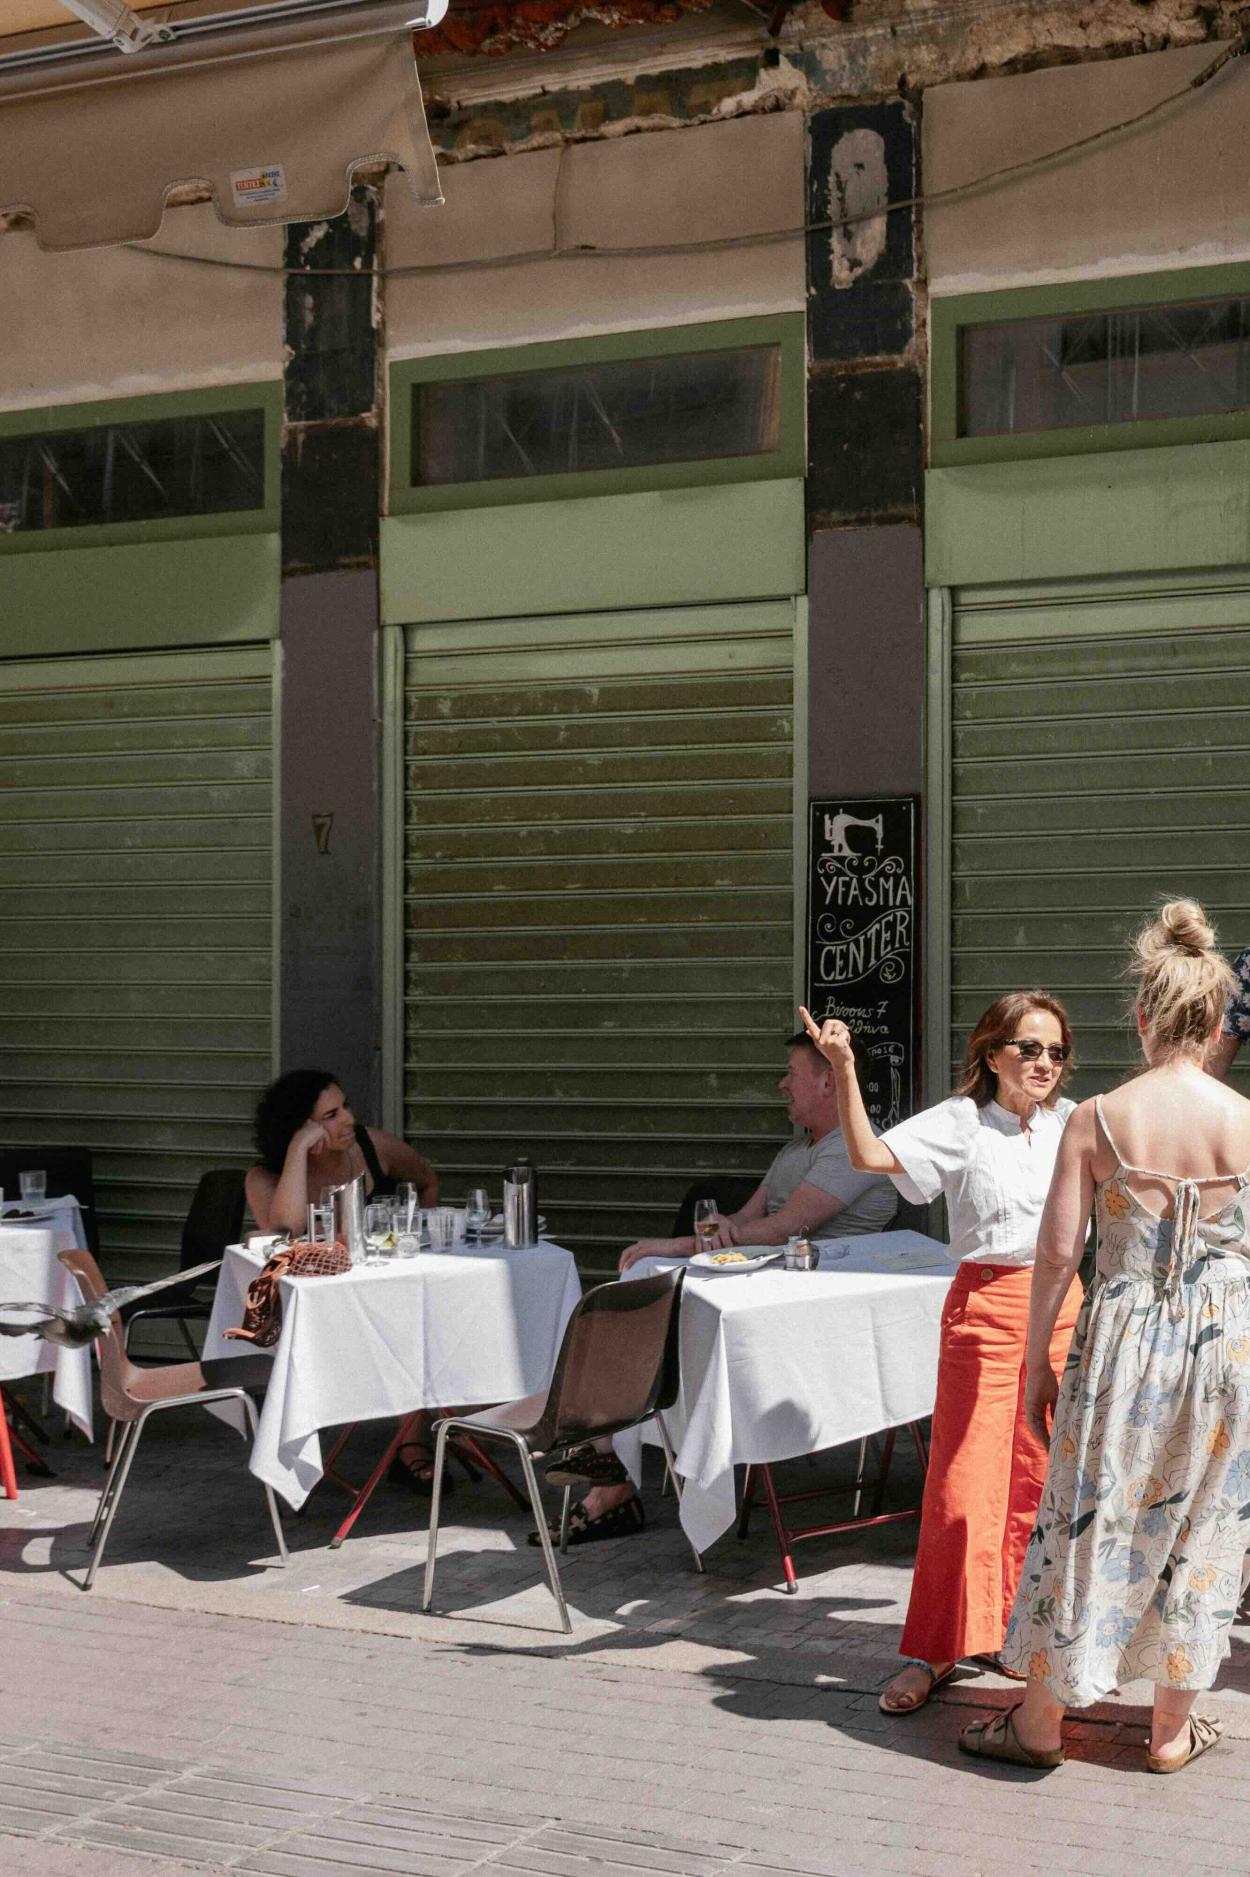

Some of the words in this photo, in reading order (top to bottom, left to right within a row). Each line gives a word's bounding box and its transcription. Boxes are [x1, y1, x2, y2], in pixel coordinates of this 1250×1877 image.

[312, 812, 334, 855] 7
[820, 875, 912, 907] YFASMA
[819, 910, 910, 981] CENTER
